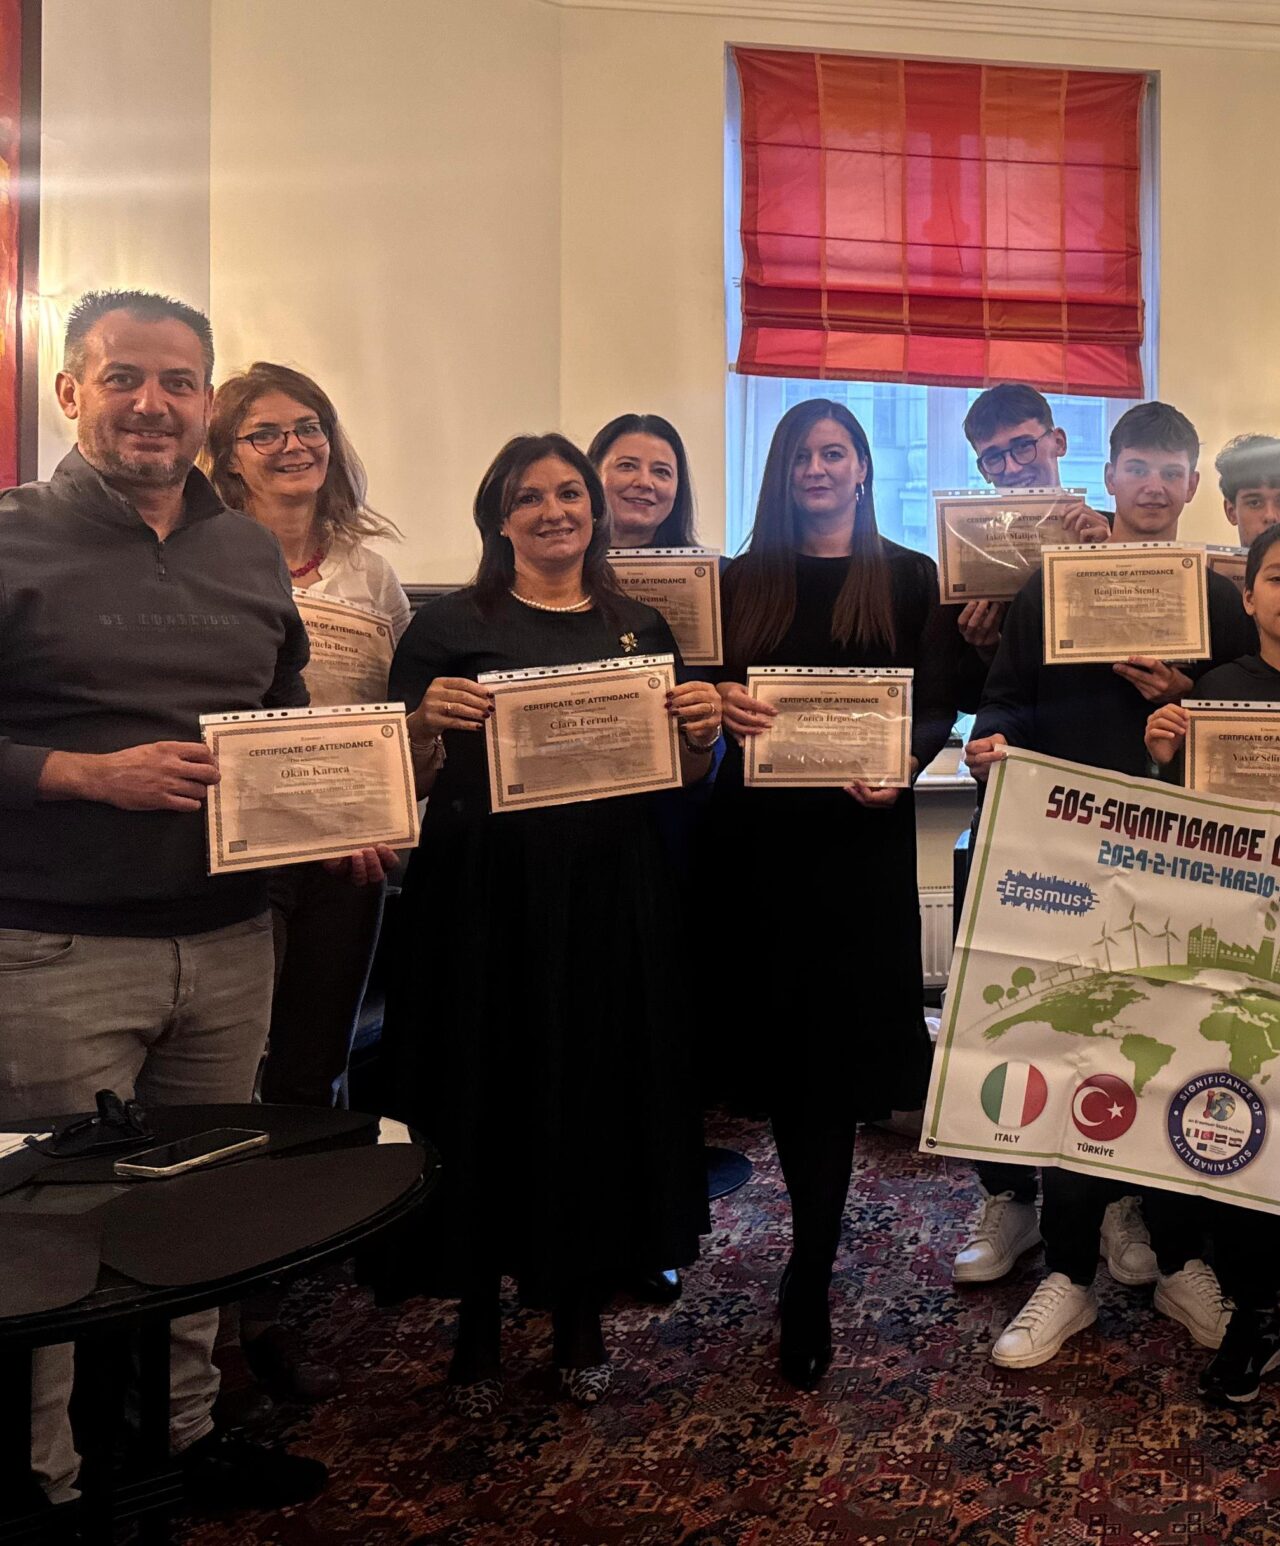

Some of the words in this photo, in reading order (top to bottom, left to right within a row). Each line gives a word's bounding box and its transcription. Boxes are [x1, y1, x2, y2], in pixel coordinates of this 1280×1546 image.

[1130, 569, 1174, 577] ATTENDANCE
[330, 624, 372, 639] ATTENDANCE
[523, 700, 573, 712] CERTIFICATE
[574, 699, 586, 707] OF
[587, 692, 640, 705] ATTENDANCE
[550, 719, 578, 730] Clara
[1218, 734, 1262, 742] CERTIFICATE
[249, 746, 304, 757] CERTIFICATE
[319, 740, 373, 751] ATTENDANCE
[281, 766, 310, 779] Okan
[1045, 785, 1266, 862] SOS-SIGNIFICANCE
[1005, 880, 1092, 907] Erasmus+
[1180, 1076, 1253, 1101] SIGNIFICANCE
[1252, 1101, 1263, 1116] OF
[994, 1132, 1020, 1144] ITALY
[1077, 1142, 1115, 1158] TÜRKİYE
[1173, 1135, 1251, 1172] SUSTAINABILITY
